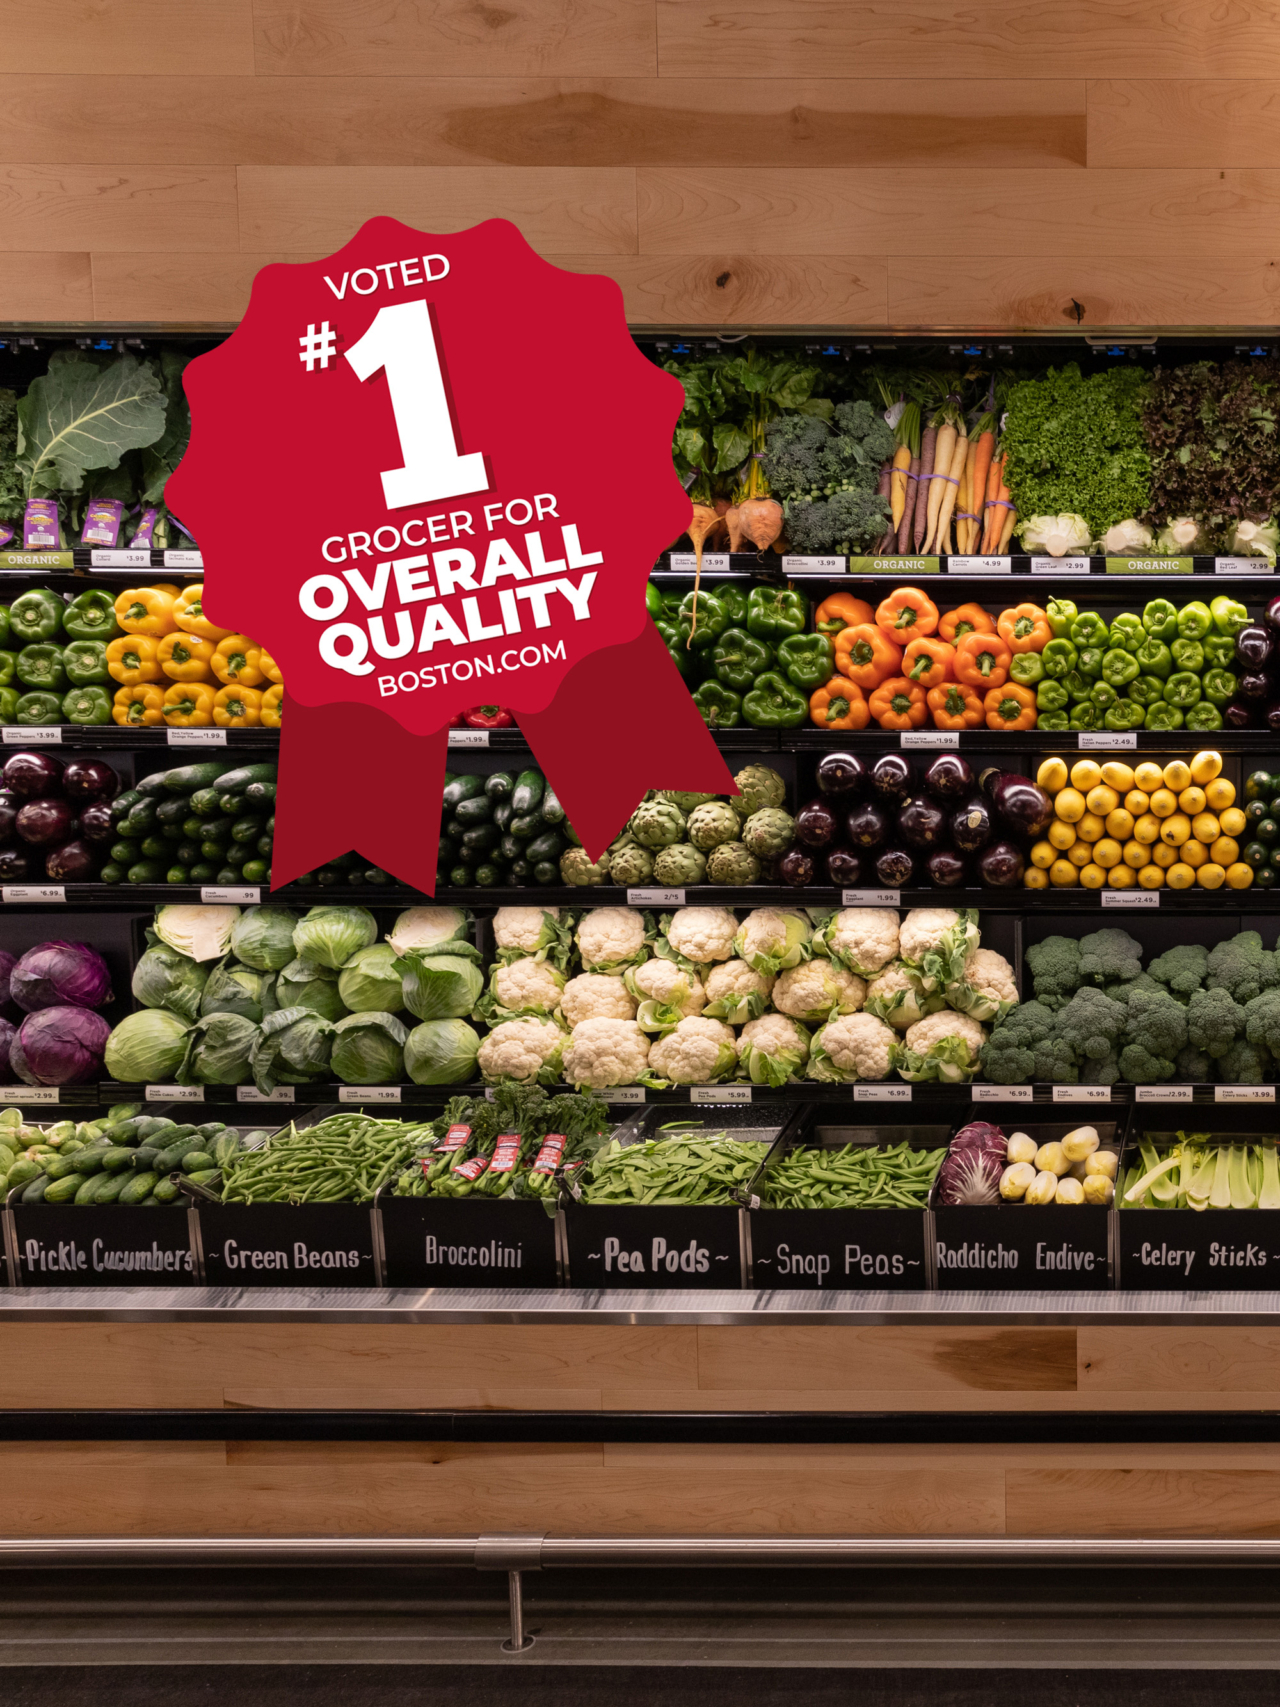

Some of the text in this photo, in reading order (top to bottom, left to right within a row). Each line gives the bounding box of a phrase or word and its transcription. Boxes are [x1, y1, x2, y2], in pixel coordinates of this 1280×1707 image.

[8, 555, 61, 565] ORGANIC
[874, 561, 925, 570] ORGANIC
[1128, 561, 1179, 570] ORGANIC
[26, 1238, 193, 1271] Pickle Cucumbers
[224, 1240, 359, 1269] Green Beans
[425, 1236, 522, 1268] Broccolini
[605, 1237, 709, 1272] Pea Pods
[777, 1244, 904, 1285] Snap Peas
[1036, 1242, 1094, 1270] Endive
[1141, 1242, 1266, 1275] Celery Sticks
